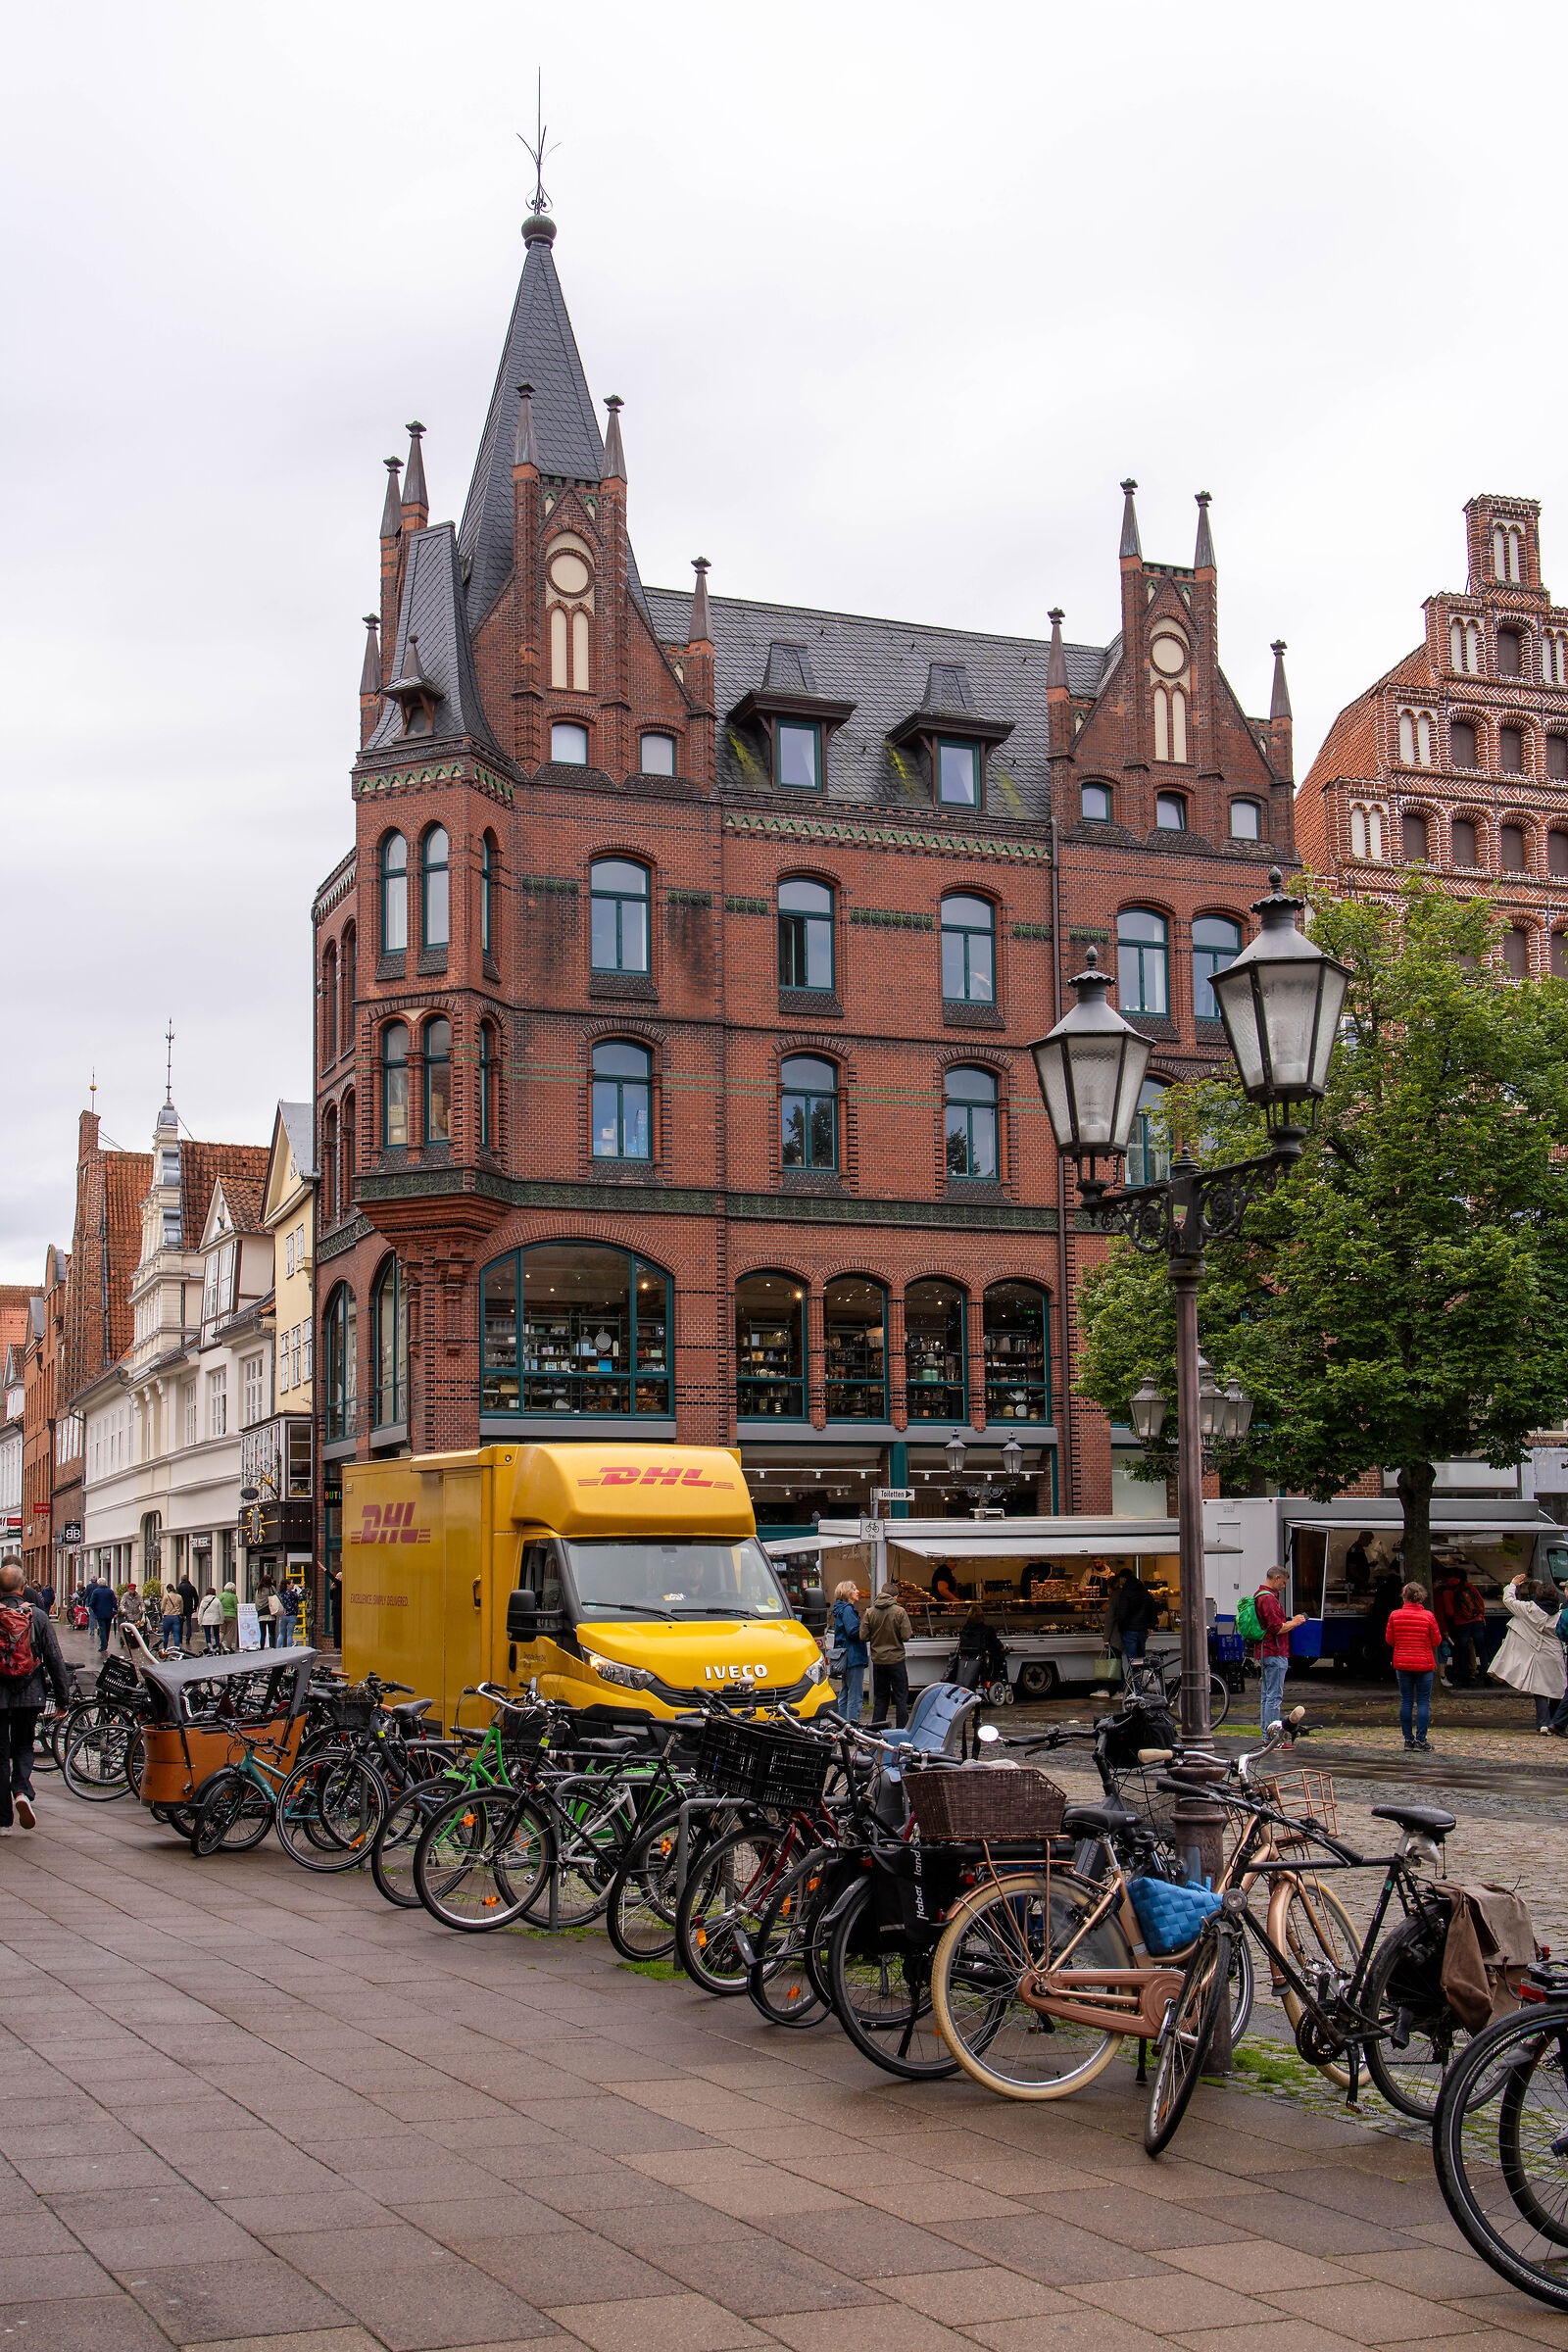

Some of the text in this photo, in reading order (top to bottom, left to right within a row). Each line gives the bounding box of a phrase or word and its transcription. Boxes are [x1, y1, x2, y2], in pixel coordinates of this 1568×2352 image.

[599, 1467, 713, 1488] DHL
[361, 1502, 418, 1544] DHL
[705, 1664, 767, 1680] IVECO
